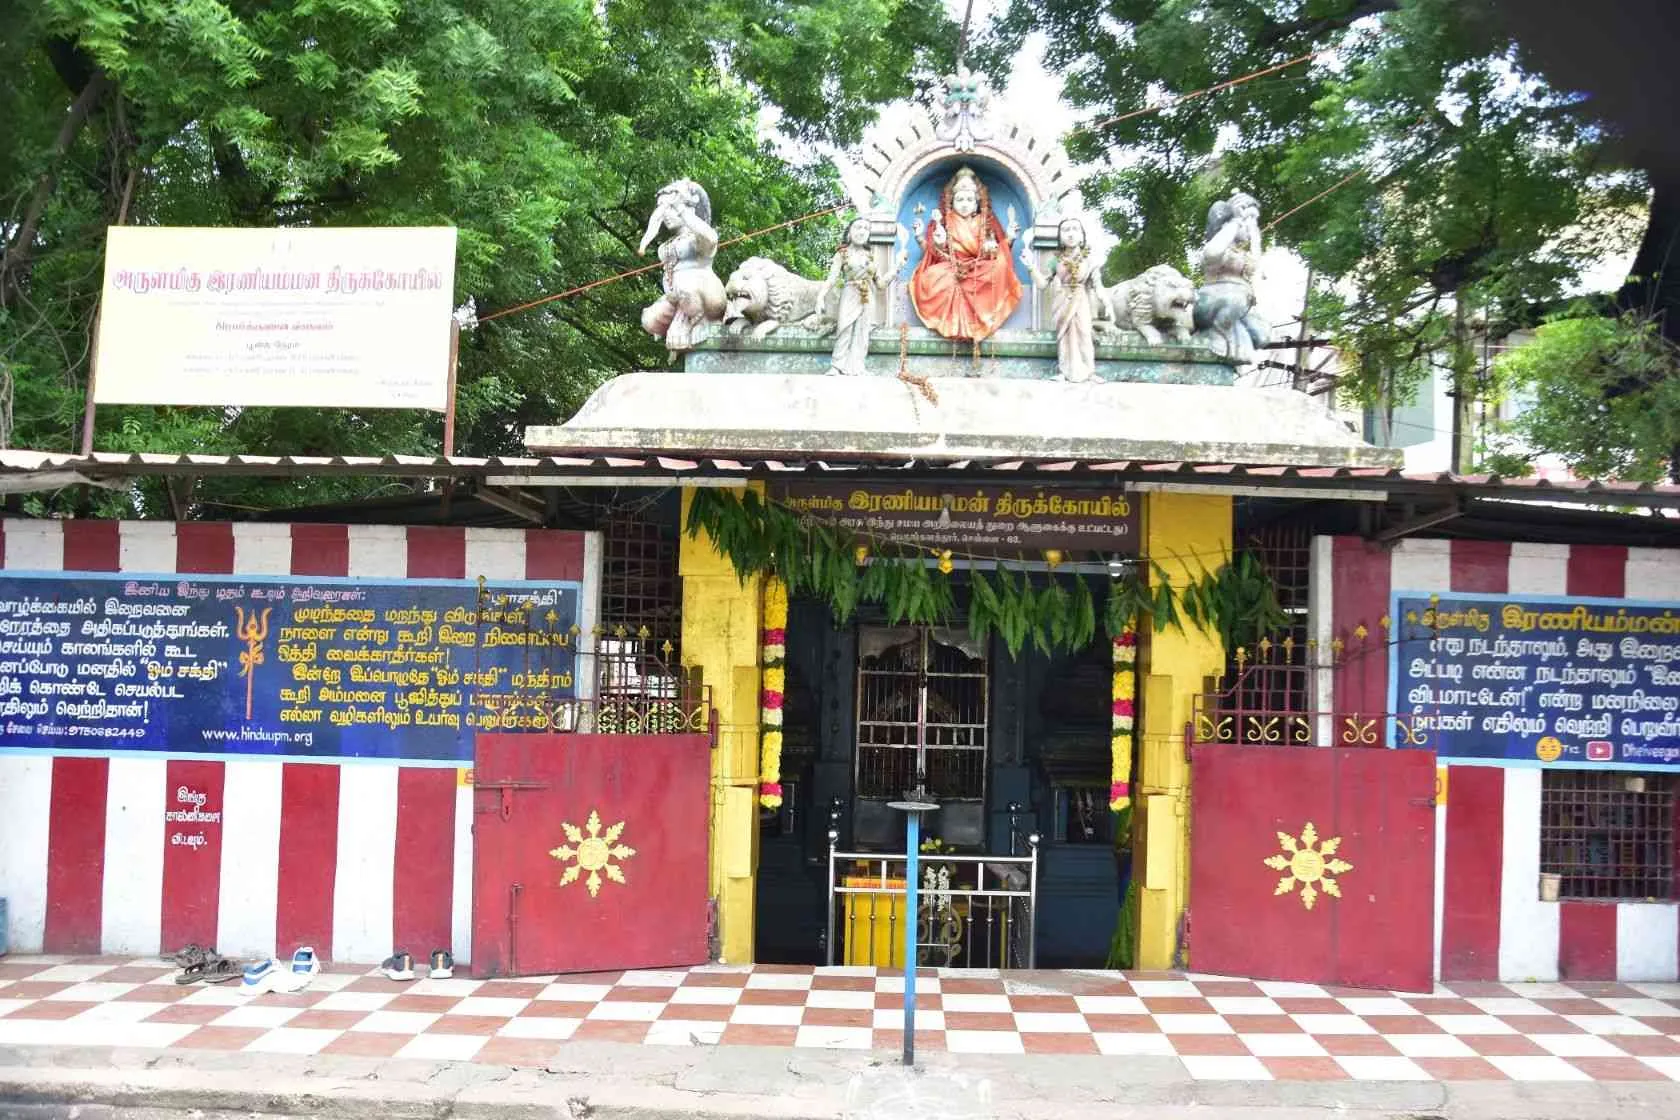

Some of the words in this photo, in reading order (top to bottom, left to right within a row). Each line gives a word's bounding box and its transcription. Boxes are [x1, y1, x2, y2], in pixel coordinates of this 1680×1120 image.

[993, 490, 1130, 518] திருக்கோயில்
[104, 597, 191, 619] இறைவனை
[81, 617, 230, 640] அதிகப்படுத்துங்கள்.
[343, 623, 389, 646] என்று
[397, 625, 433, 647] கூறி
[61, 637, 157, 658] காலங்களில்
[164, 644, 198, 658] கூட
[1576, 638, 1614, 662] அது
[77, 657, 137, 679] மனதில்
[1472, 660, 1528, 681] என்ன
[1533, 661, 1638, 689] நடந்தாலும்
[29, 677, 107, 697] கொண்டே
[114, 680, 185, 698] செயல்பட
[280, 685, 311, 704] கூறி
[55, 698, 150, 724] வெற்றிதான்!
[280, 705, 323, 723] எல்லா
[1482, 710, 1547, 739] எதிலும்
[1554, 712, 1613, 738] வெற்றி
